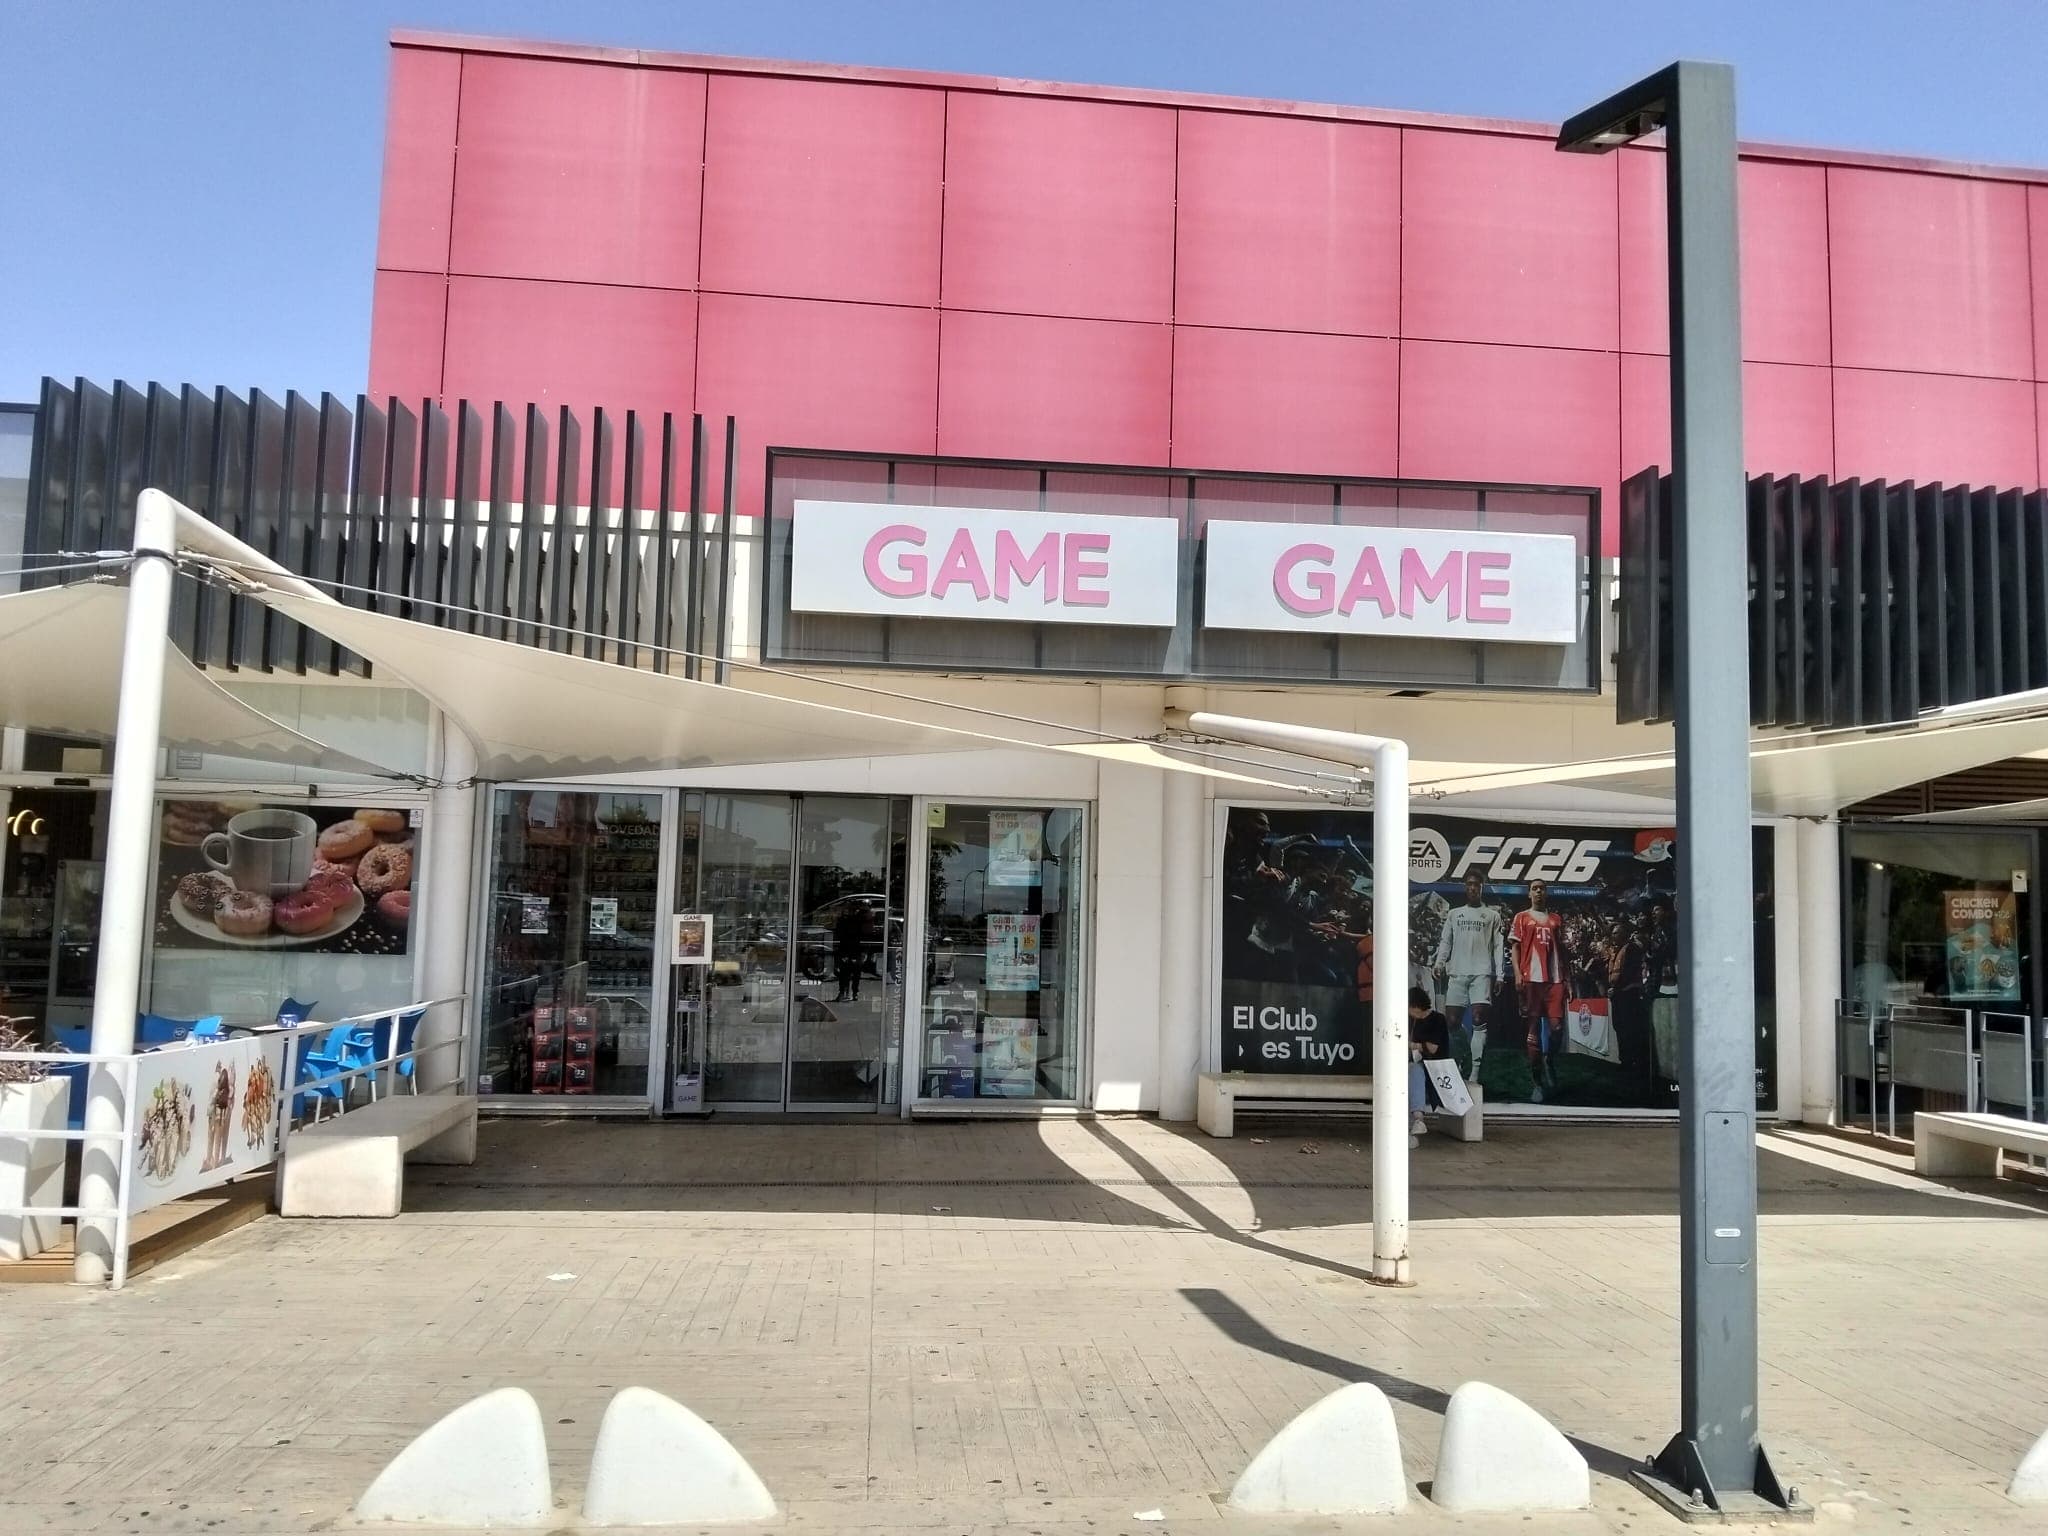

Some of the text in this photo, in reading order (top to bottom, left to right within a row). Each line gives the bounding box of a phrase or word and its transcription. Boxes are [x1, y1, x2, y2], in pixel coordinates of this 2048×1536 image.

[862, 524, 1112, 607] GAME
[1272, 542, 1512, 625] GAME
[1408, 840, 1440, 858] EA
[1952, 909, 1992, 919] COMBO
[1233, 1006, 1318, 1032] El Club
[1262, 1036, 1355, 1066] es Tuyo
